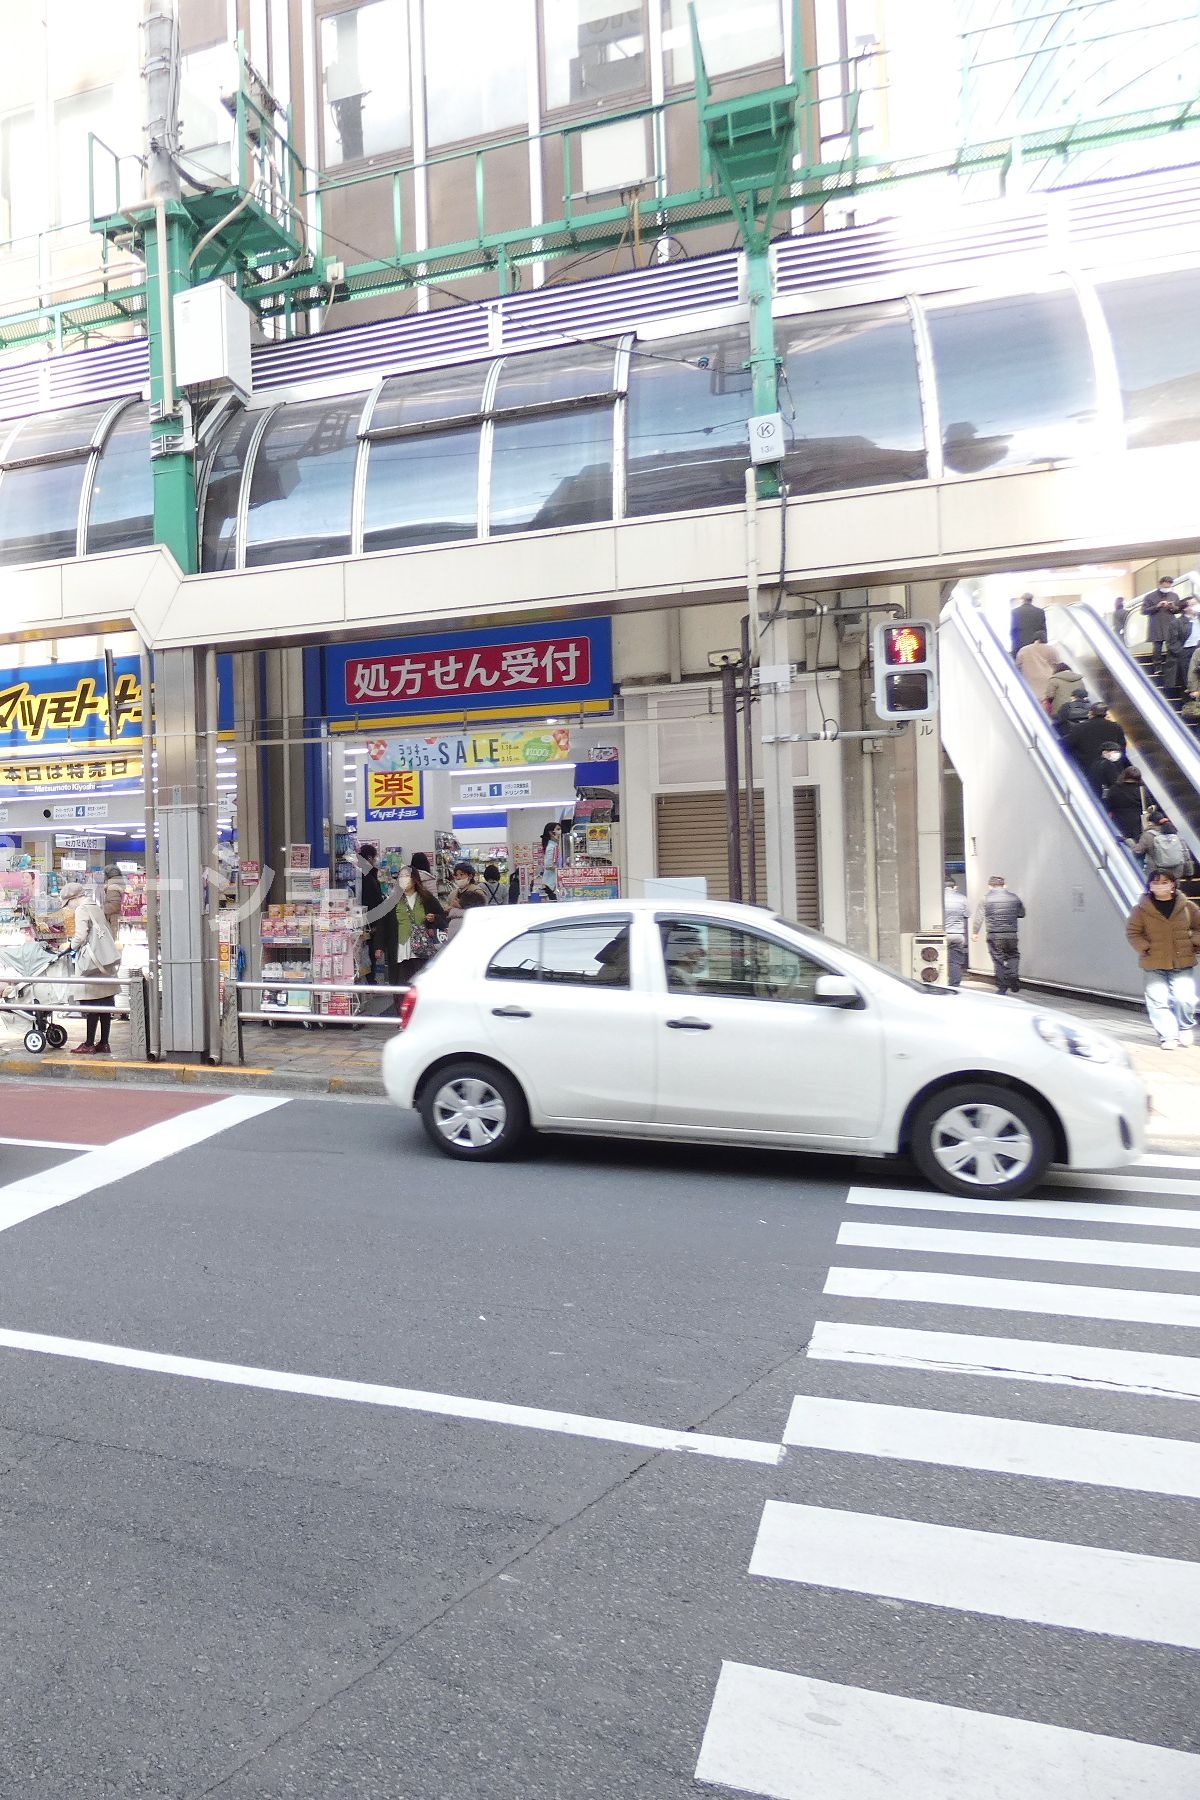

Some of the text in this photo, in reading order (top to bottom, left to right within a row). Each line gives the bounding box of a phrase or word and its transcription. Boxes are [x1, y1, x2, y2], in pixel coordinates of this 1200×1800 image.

[353, 643, 581, 699] 処方せん受付
[437, 738, 500, 765] SALE
[3, 759, 128, 782] 本日は特売日
[34, 784, 96, 793] Matsumoto Kiyoshi
[373, 771, 414, 807] 薬
[369, 808, 419, 821] マツモトキヨシ
